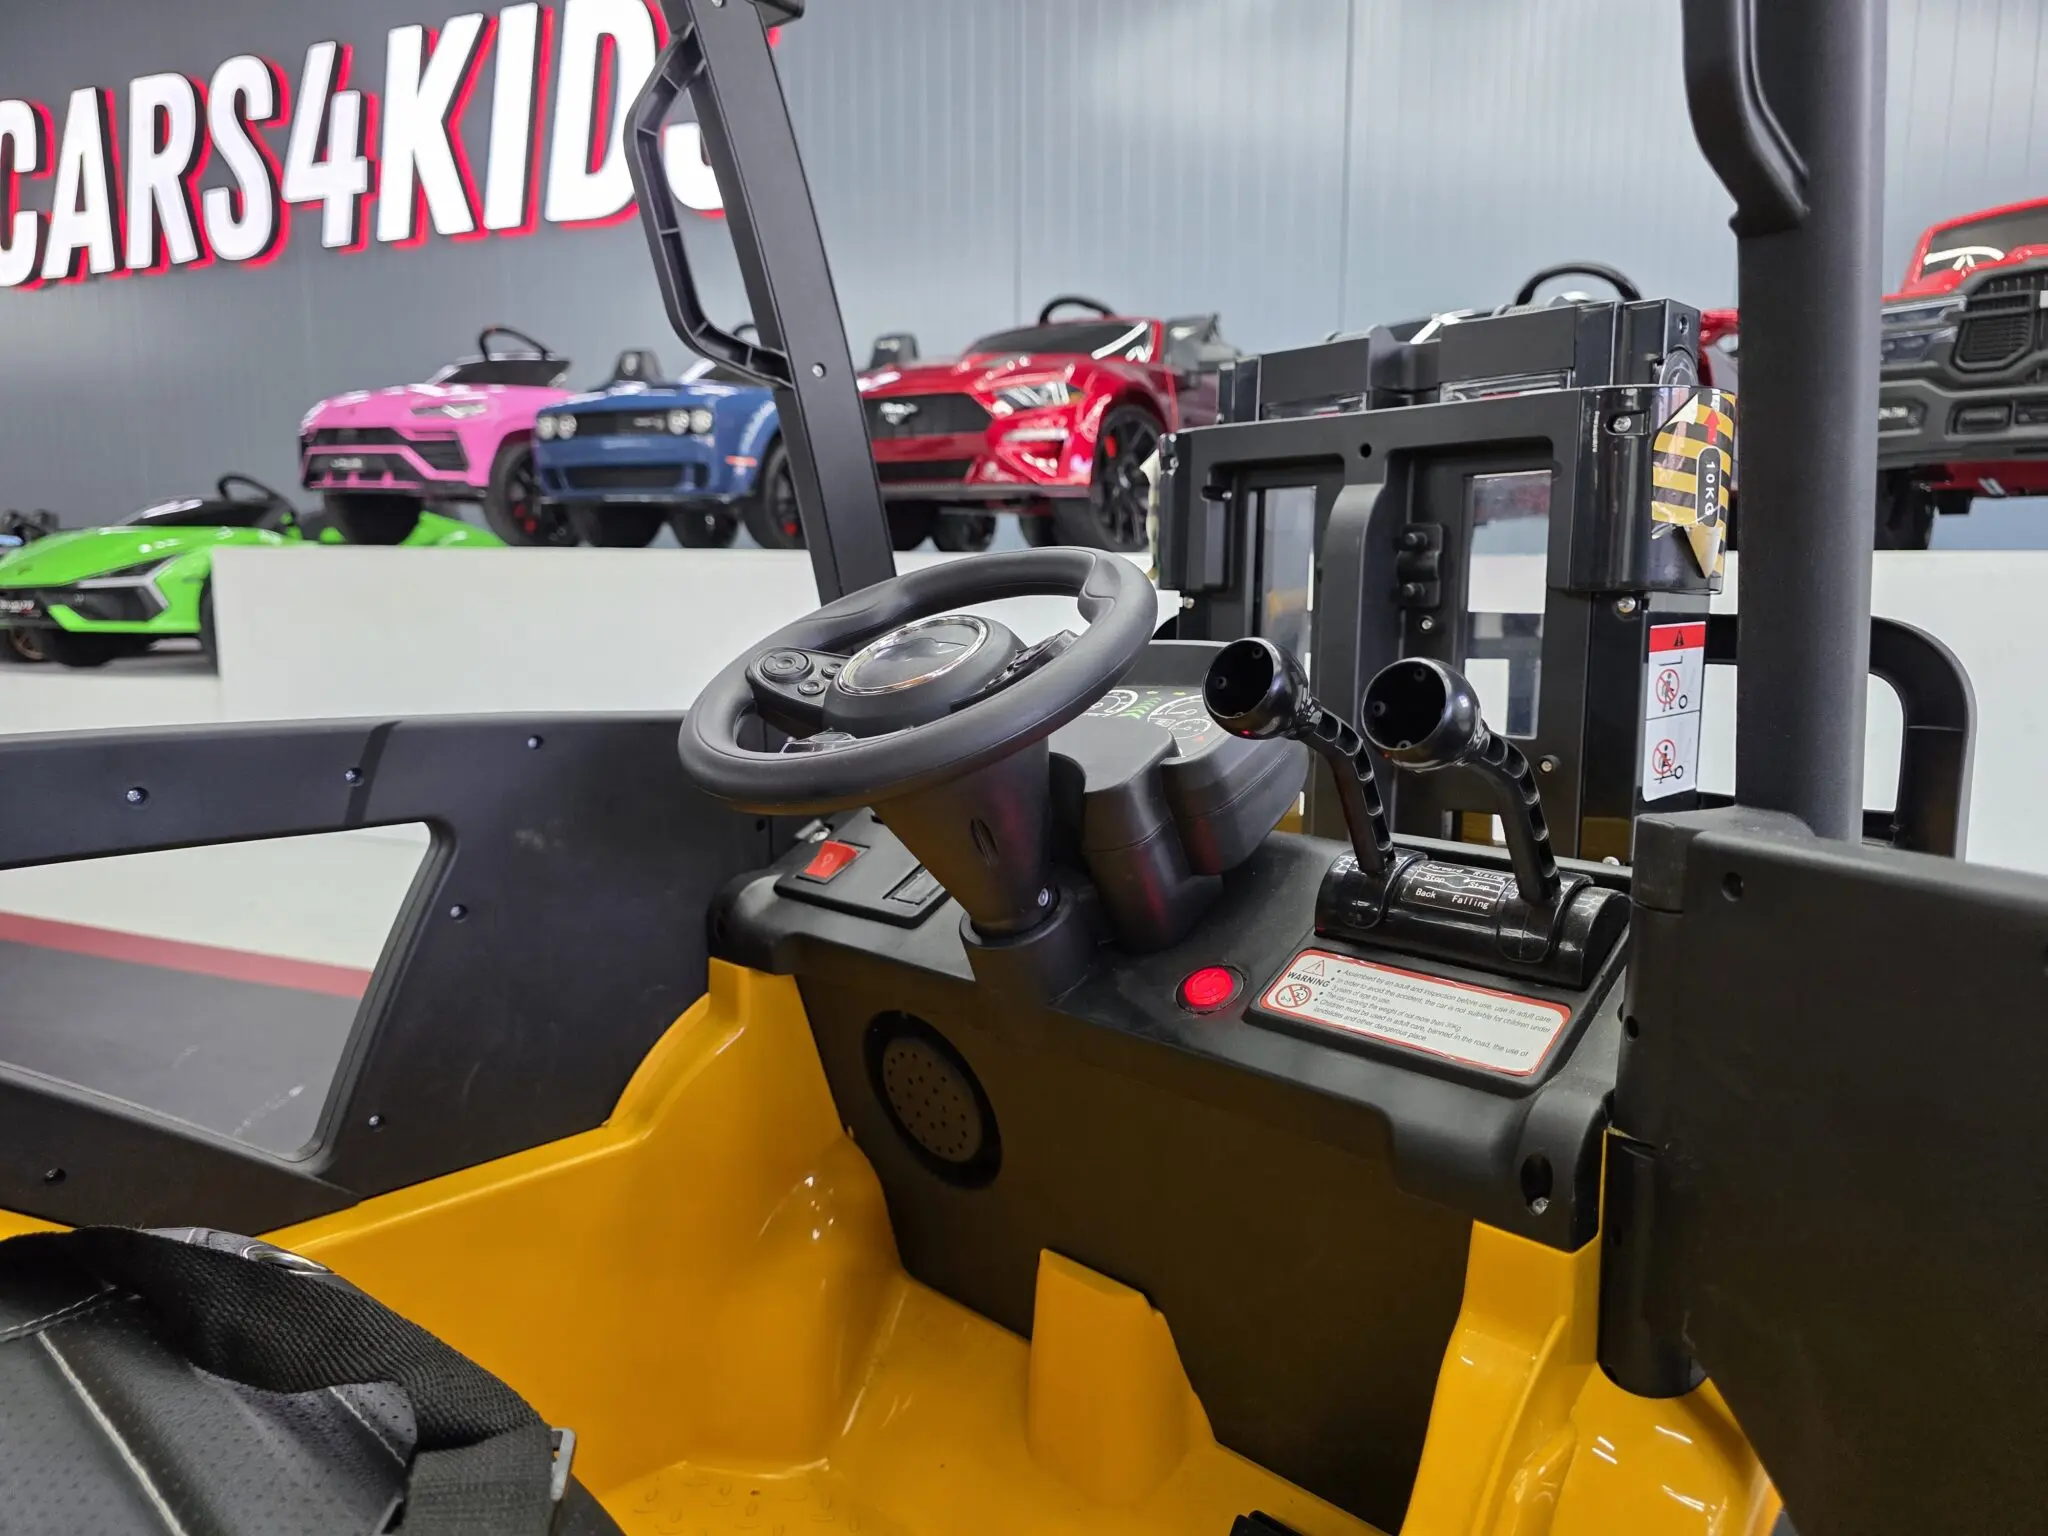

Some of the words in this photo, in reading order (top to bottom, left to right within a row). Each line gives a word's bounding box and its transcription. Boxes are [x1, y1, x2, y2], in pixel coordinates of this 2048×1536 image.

[0, 0, 724, 288] CARS4KID
[1705, 461, 1716, 516] 10KG
[1427, 864, 1464, 874] Forward
[1473, 871, 1505, 881] Rising
[1425, 874, 1446, 885] Stop
[1469, 882, 1490, 891] Stop
[1415, 888, 1437, 899] Back
[1452, 894, 1490, 911] Falling
[1287, 971, 1330, 987] WARNING
[1343, 970, 1377, 981] Assembled
[1410, 985, 1424, 993] and
[1424, 990, 1456, 1000] inspection
[1457, 996, 1478, 1006] before
[1517, 1011, 1535, 1019] adult
[1385, 988, 1396, 997] the
[1468, 1010, 1493, 1020] suitable
[1503, 1018, 1529, 1029] children
[1530, 1024, 1551, 1033] under
[1343, 1014, 1358, 1022] and
[1356, 1018, 1374, 1026] other
[1374, 1023, 1409, 1037] dangerous
[1344, 1006, 1361, 1014] must
[1427, 1027, 1454, 1039] banned
[1461, 1035, 1473, 1043] the
[1491, 1043, 1505, 1051] the
[1505, 1047, 1519, 1055] use
